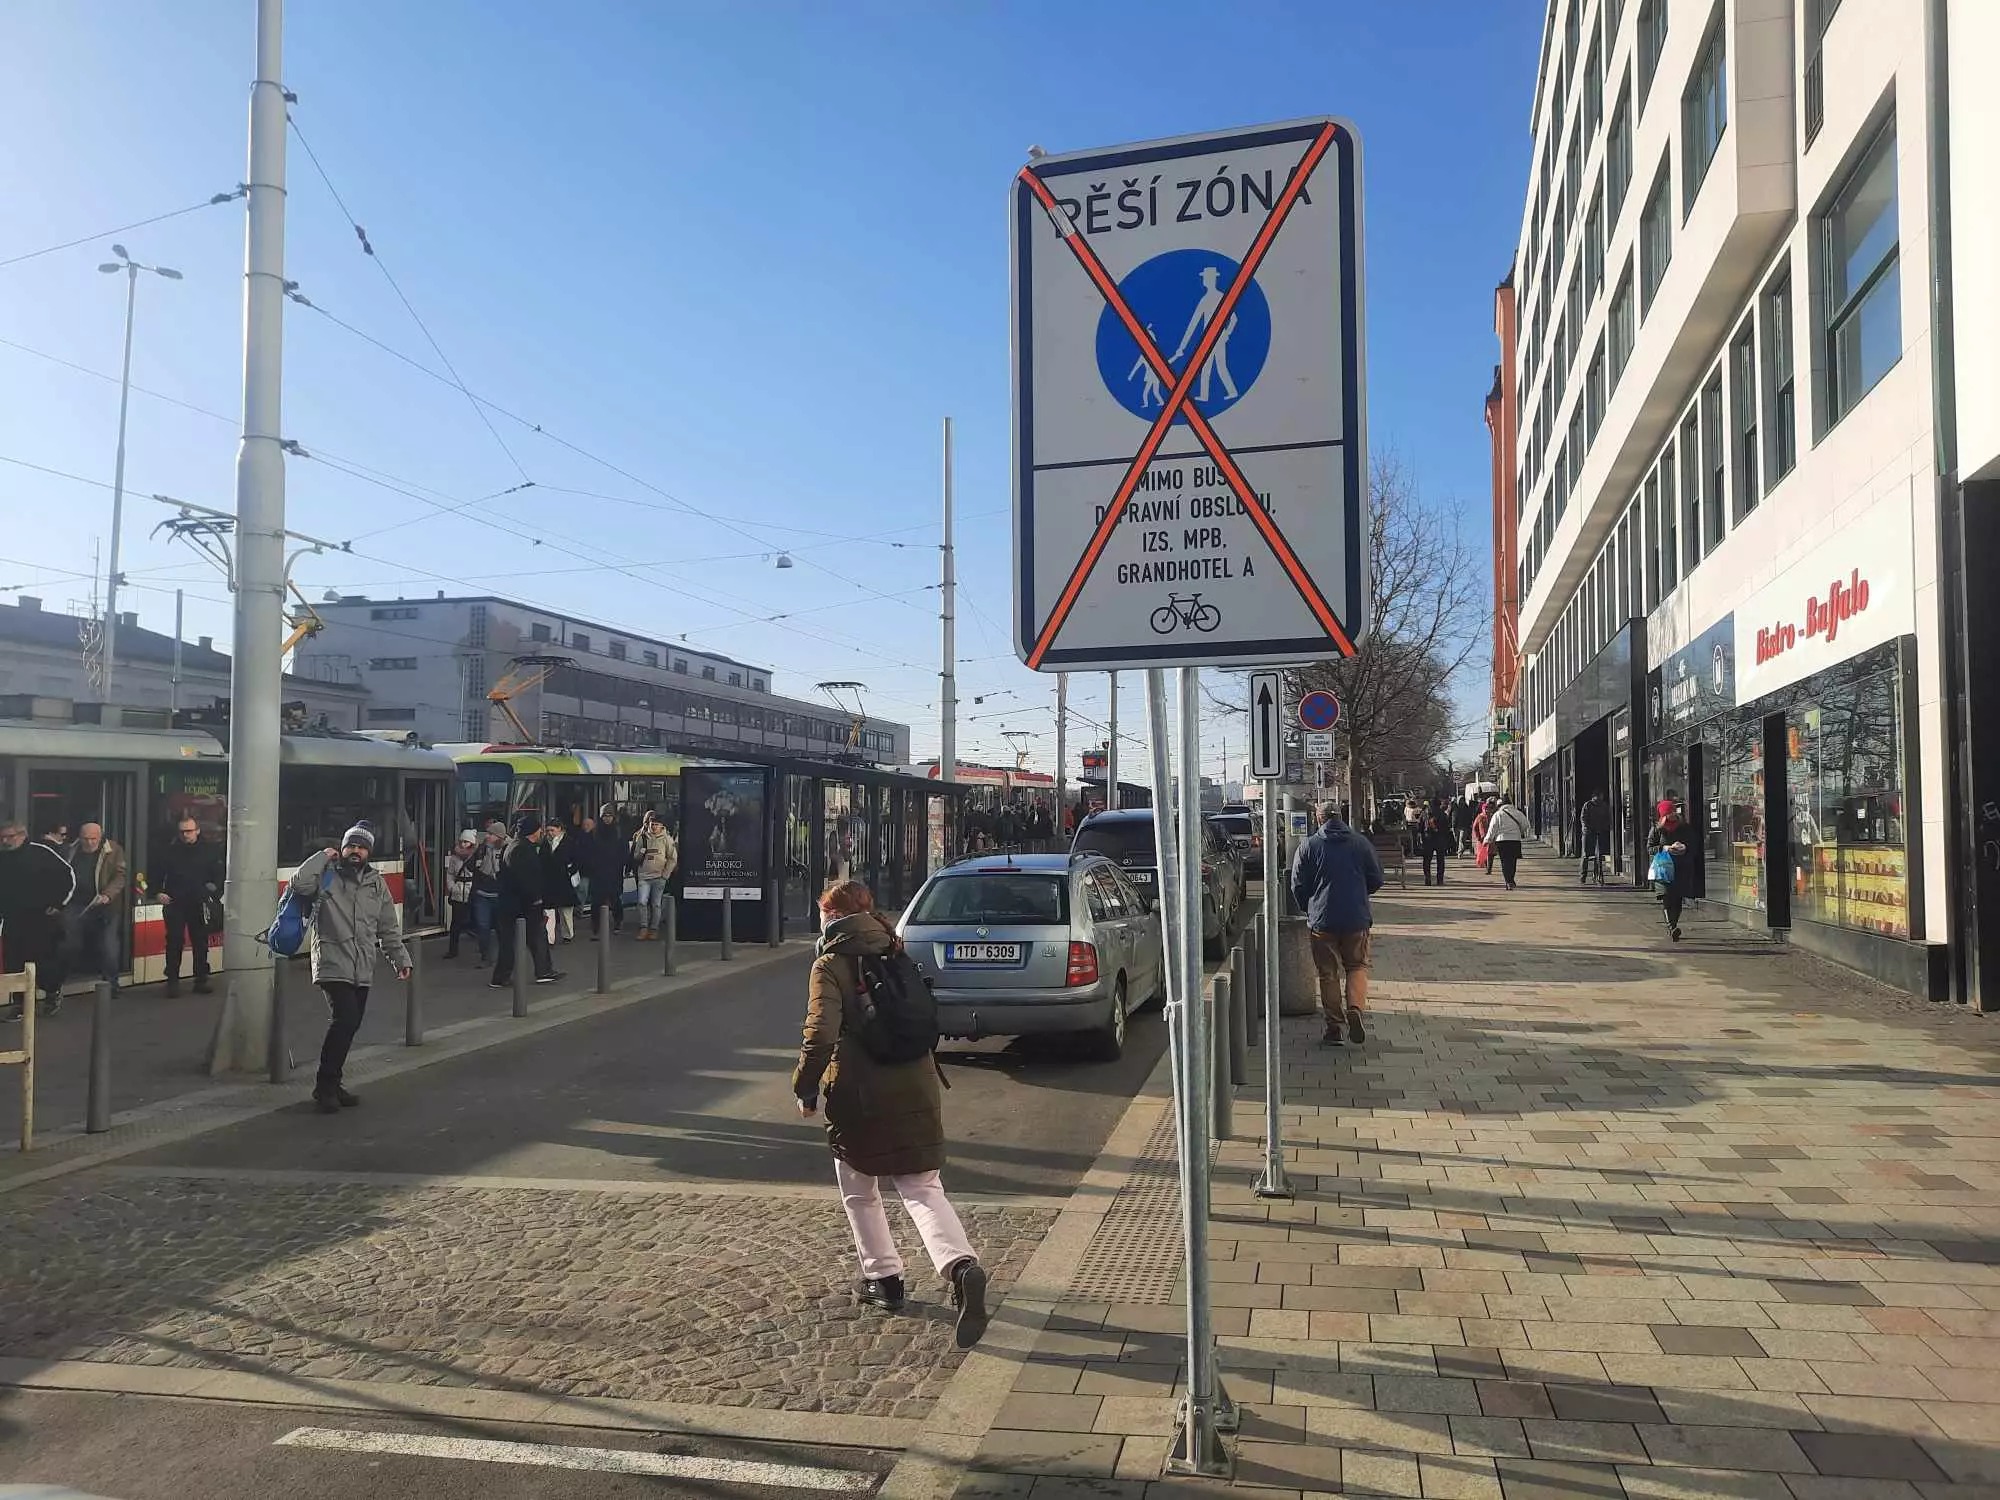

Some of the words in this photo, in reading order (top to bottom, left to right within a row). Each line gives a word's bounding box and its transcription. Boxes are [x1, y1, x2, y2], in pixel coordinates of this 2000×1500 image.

[1055, 174, 1162, 239] PĚŠÍ
[1135, 469, 1184, 492] MIMO
[1117, 557, 1233, 584] GRANDHOTEL
[1242, 556, 1255, 577] A
[1755, 621, 1796, 666] Bistro
[1805, 567, 1870, 643] Buffalo
[705, 860, 743, 869] BAROKO
[956, 945, 977, 958] 1TD
[986, 945, 1015, 958] 6309
